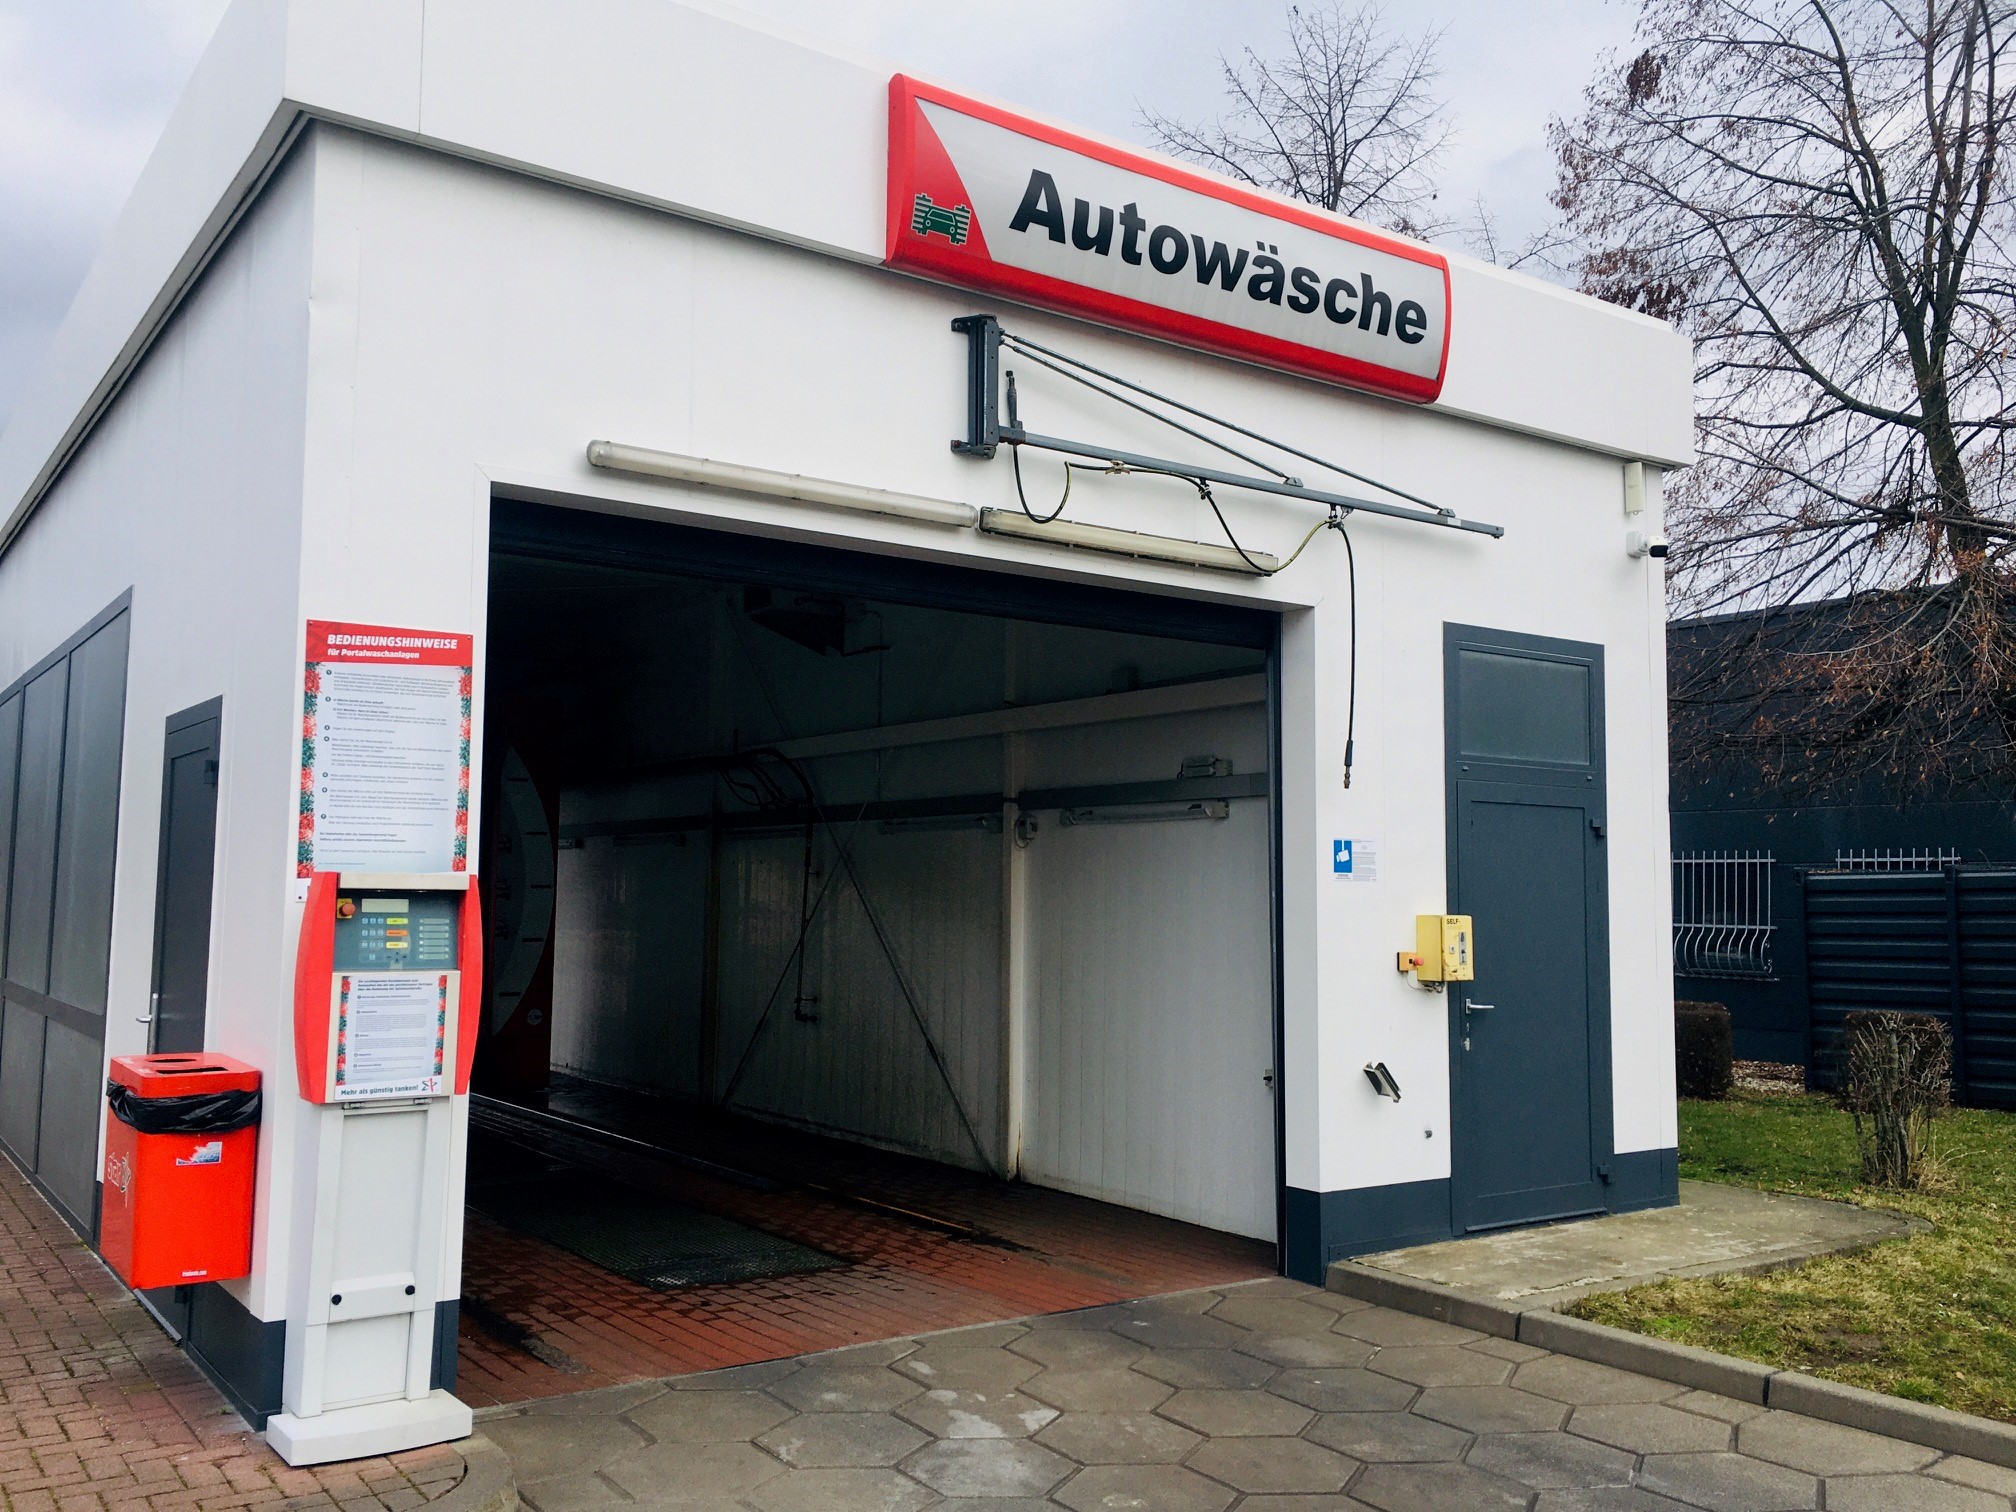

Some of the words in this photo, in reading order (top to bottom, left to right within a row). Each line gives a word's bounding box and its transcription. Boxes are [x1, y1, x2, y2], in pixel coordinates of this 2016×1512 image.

[1009, 168, 1427, 345] Autowäsche
[327, 634, 458, 649] BEDIENUNGSHINWEISE
[327, 648, 340, 656] für
[341, 649, 420, 659] Portalwaschanlagen
[369, 1086, 393, 1095] günstig
